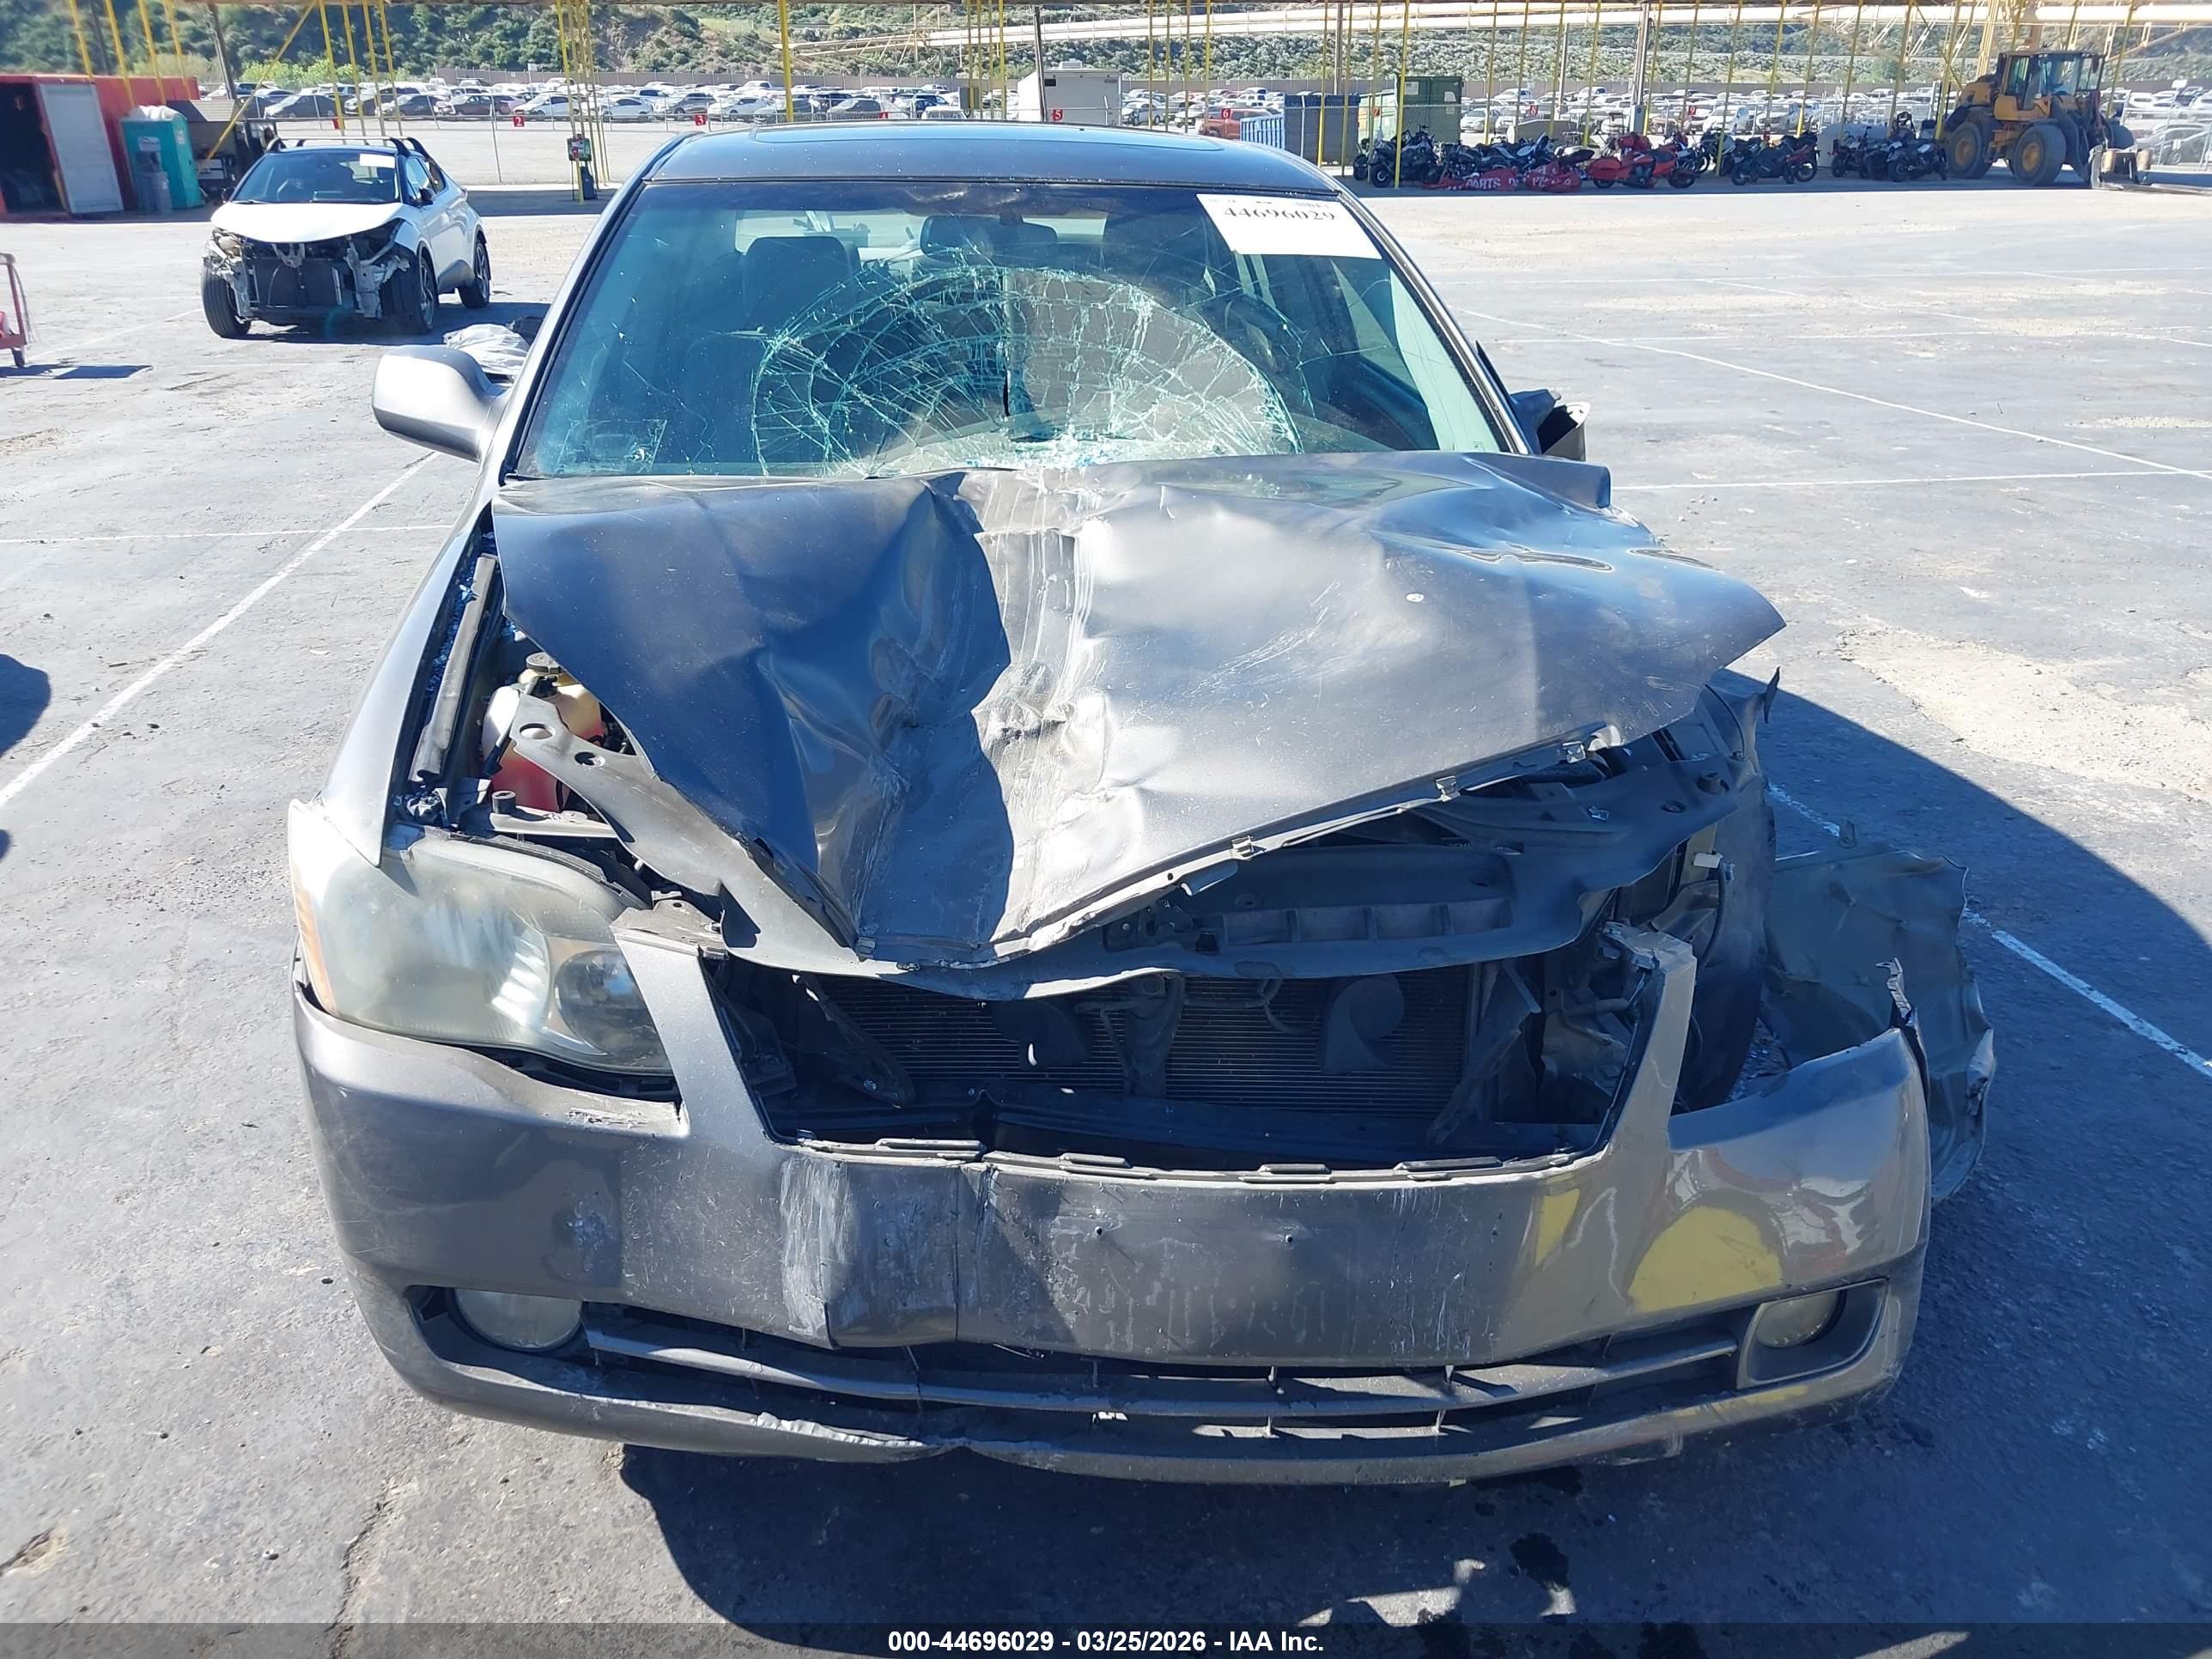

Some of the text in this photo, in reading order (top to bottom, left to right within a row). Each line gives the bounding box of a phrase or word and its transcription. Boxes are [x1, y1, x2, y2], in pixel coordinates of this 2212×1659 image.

[1054, 109, 1061, 120] 5
[1223, 109, 1229, 118] 6
[514, 116, 522, 126] 2
[697, 115, 704, 125] 3
[1224, 207, 1335, 221] 44696029
